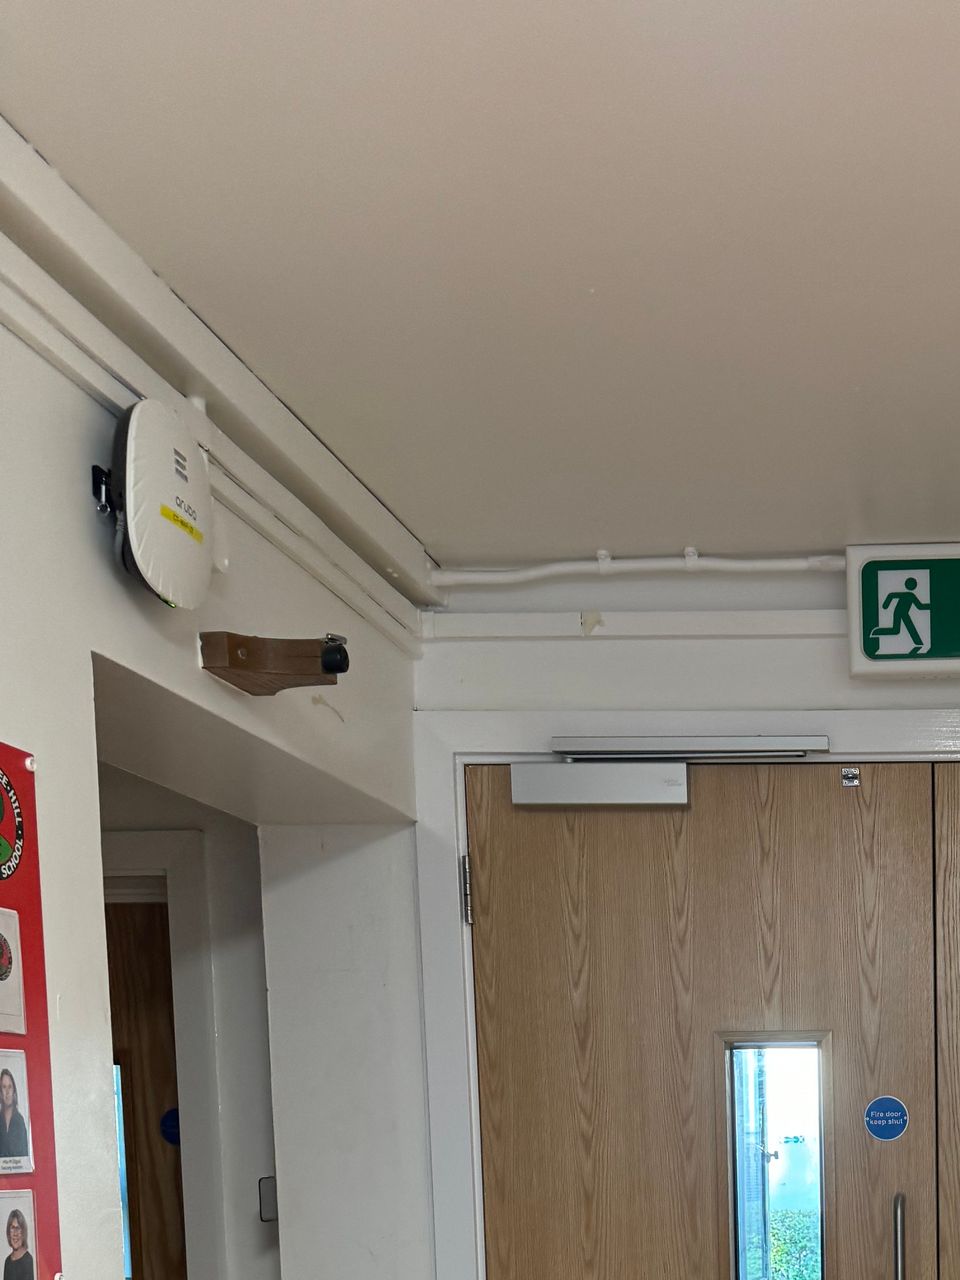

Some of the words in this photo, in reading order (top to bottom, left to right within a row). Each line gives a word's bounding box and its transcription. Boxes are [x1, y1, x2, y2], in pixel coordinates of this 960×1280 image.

[8, 789, 22, 825] HILL
[1, 839, 23, 878] SCHOOL
[869, 1118, 886, 1126] keep
